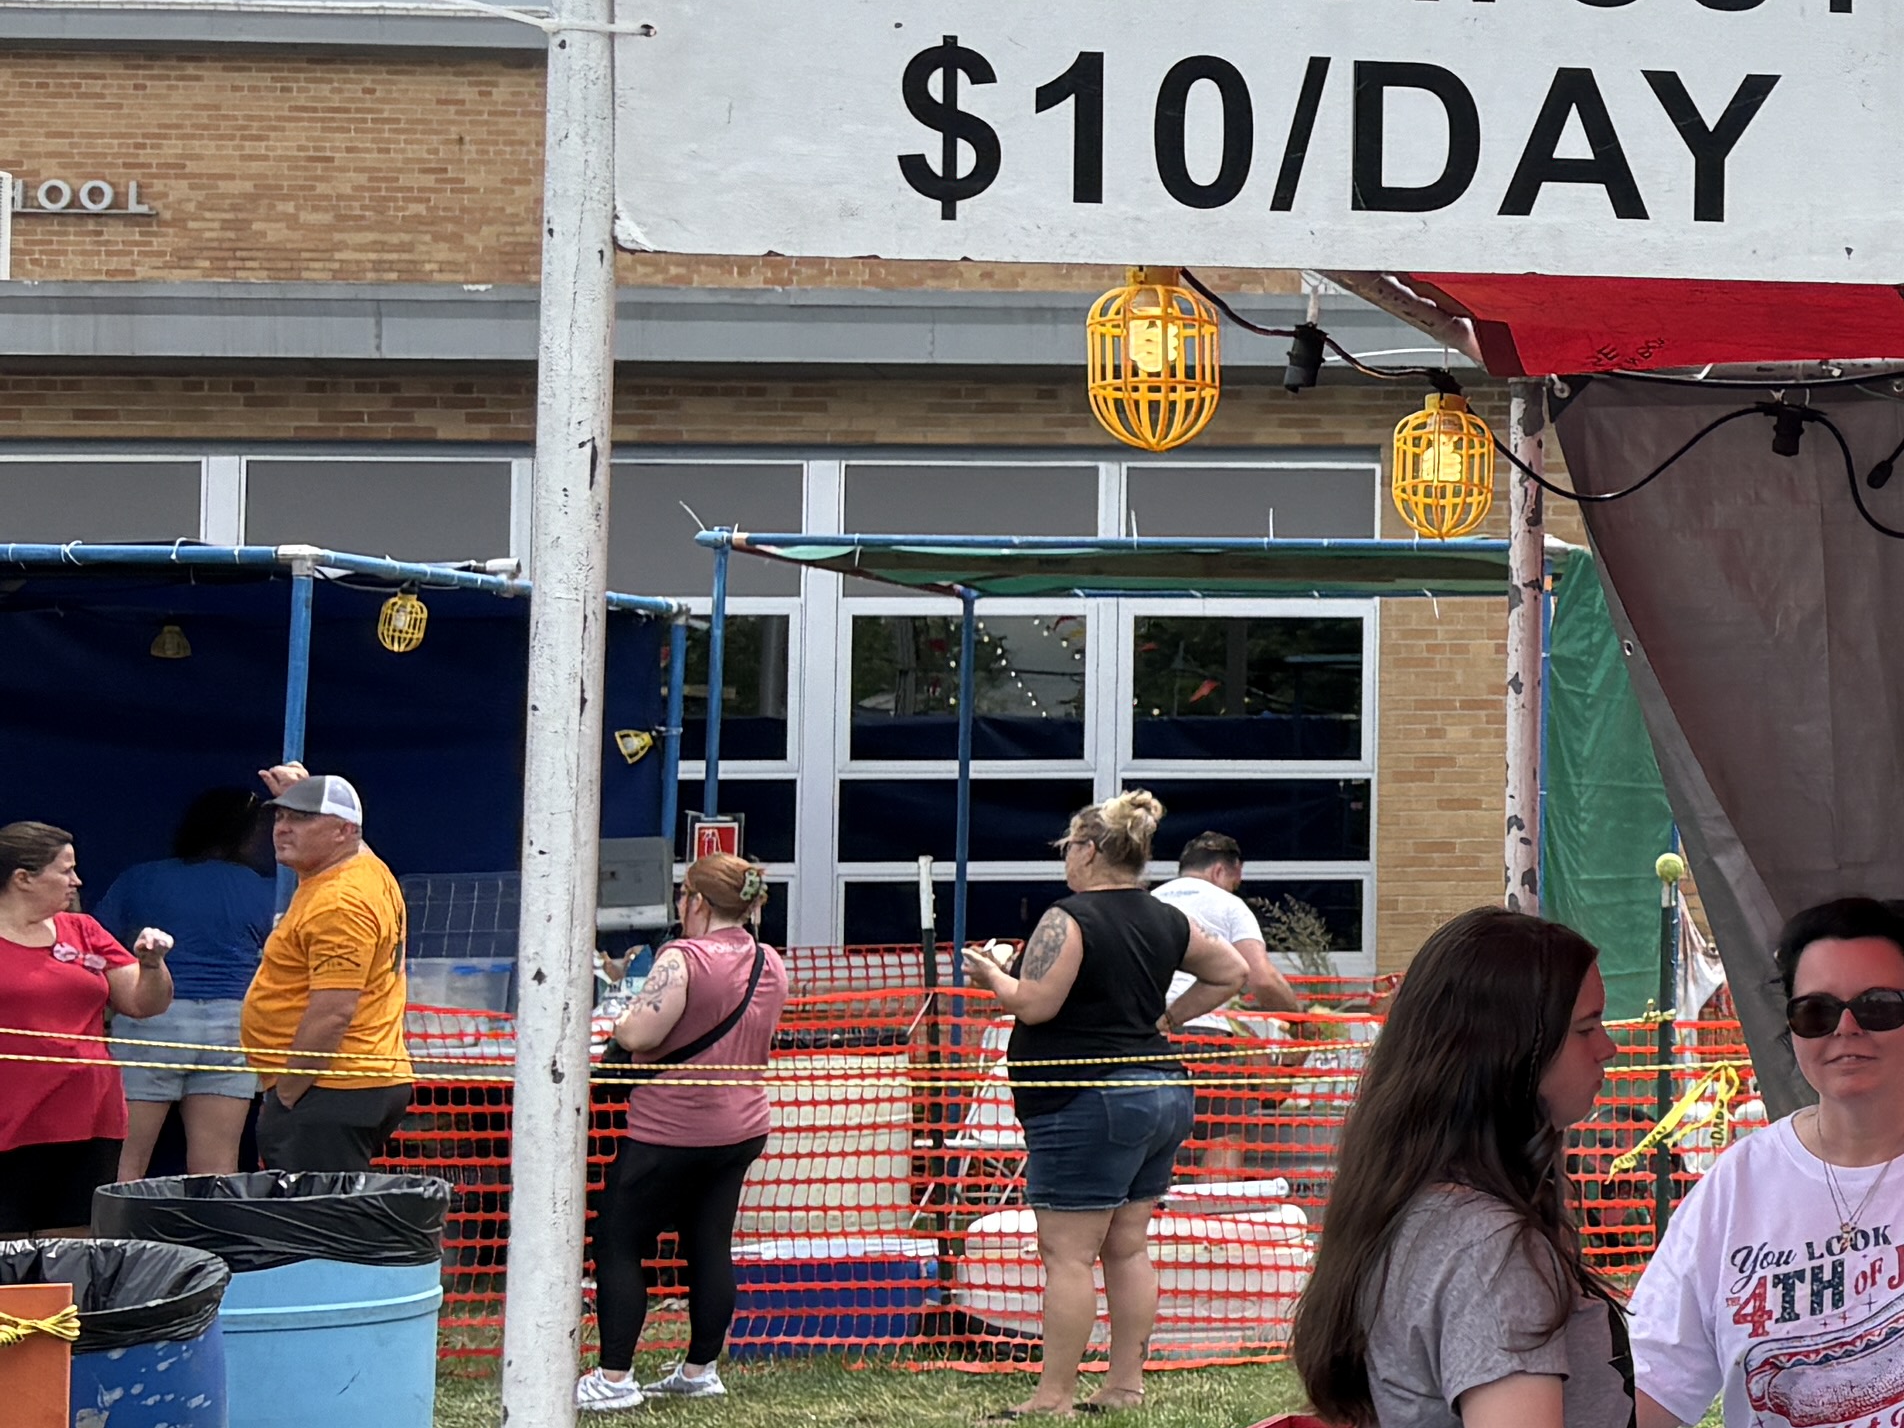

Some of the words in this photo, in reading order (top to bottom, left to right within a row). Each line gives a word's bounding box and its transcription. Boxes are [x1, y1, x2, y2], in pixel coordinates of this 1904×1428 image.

[897, 34, 1781, 223] $10/DAY
[1806, 1225, 1891, 1262] LOOK
[1733, 1257, 1845, 1338] 4TH
[1854, 1257, 1883, 1296] OF
